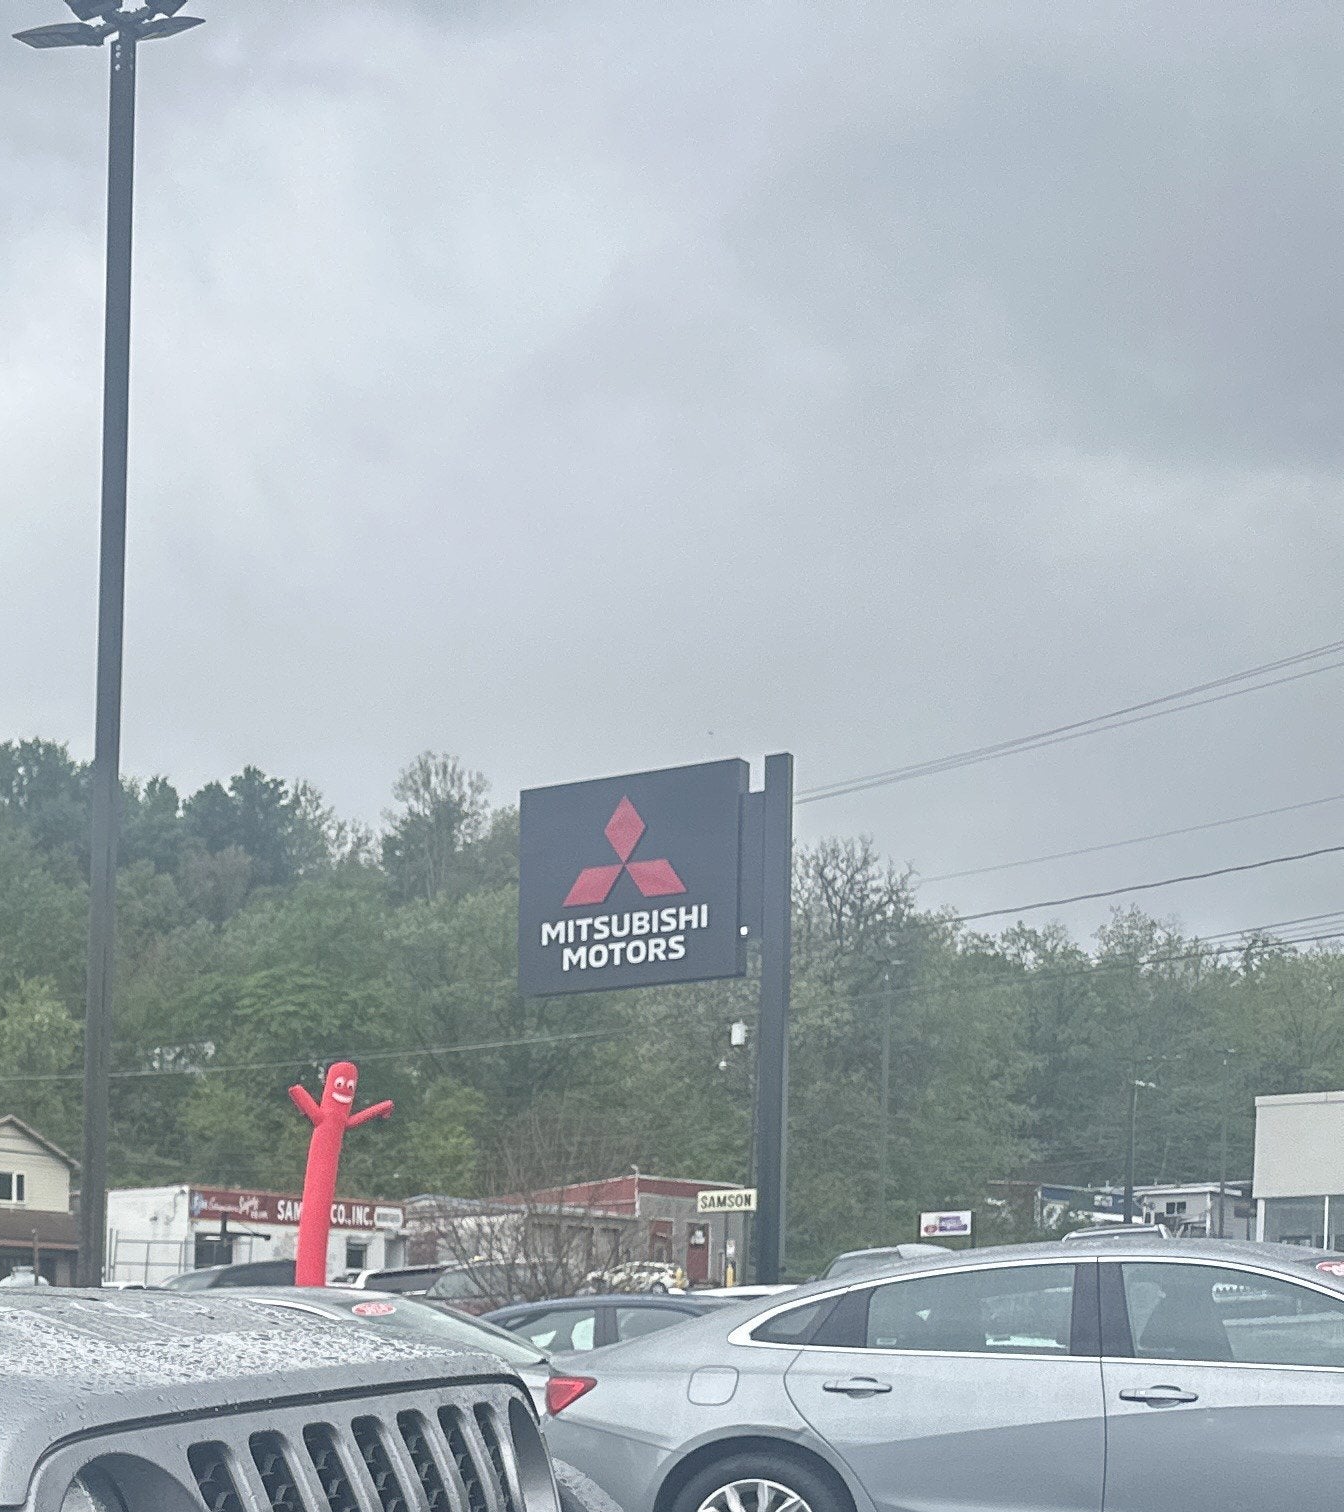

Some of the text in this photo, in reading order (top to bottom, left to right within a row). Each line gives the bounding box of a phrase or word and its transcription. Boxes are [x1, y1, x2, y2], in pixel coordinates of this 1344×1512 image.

[541, 904, 708, 946] MITSUBISHI
[562, 935, 686, 972] MOTORS
[701, 1194, 752, 1209] SAMSON
